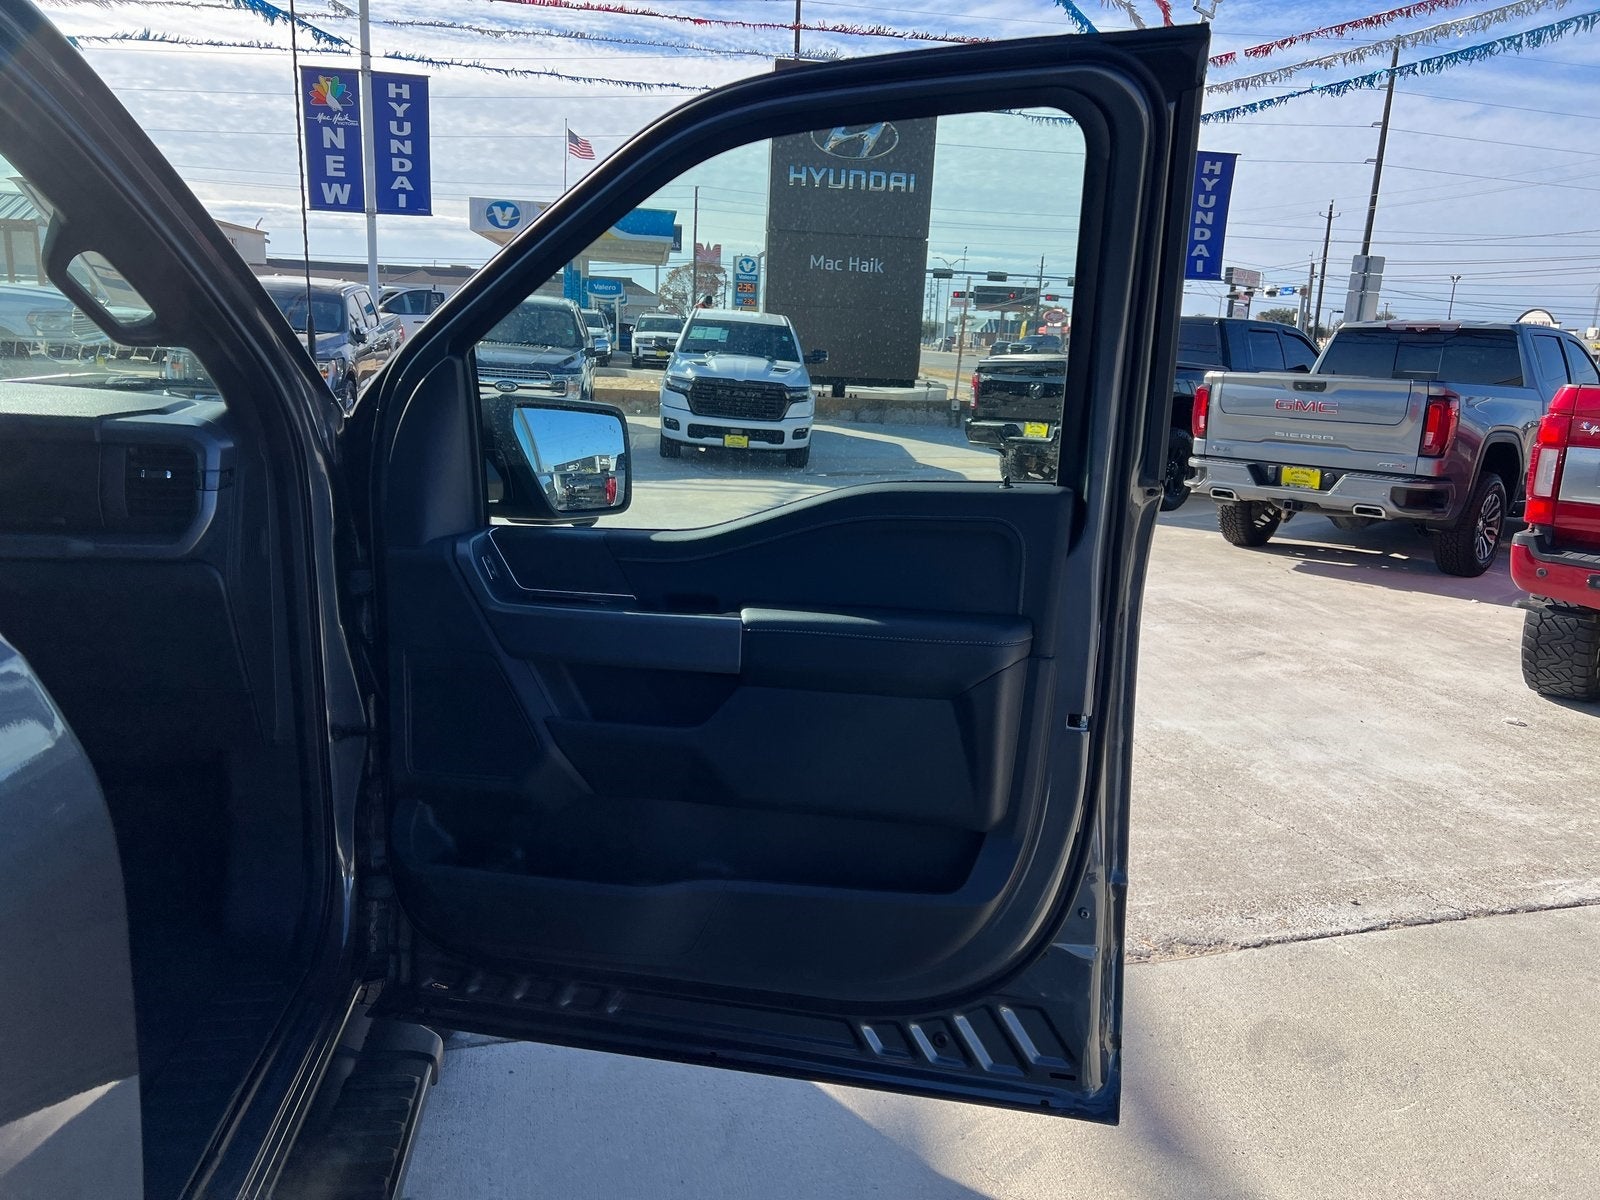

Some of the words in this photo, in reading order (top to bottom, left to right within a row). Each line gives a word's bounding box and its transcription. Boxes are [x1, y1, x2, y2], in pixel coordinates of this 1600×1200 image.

[332, 112, 356, 125] Haik
[388, 82, 415, 208] HYUNDAI
[321, 126, 351, 205] NEW
[788, 164, 916, 193] HYUNDAI
[1191, 160, 1223, 273] HYUNDAI
[809, 254, 842, 272] Mac
[849, 255, 884, 274] Haik
[593, 283, 617, 291] Valero
[1275, 398, 1338, 415] GMC
[1273, 431, 1334, 441] SIERRA
